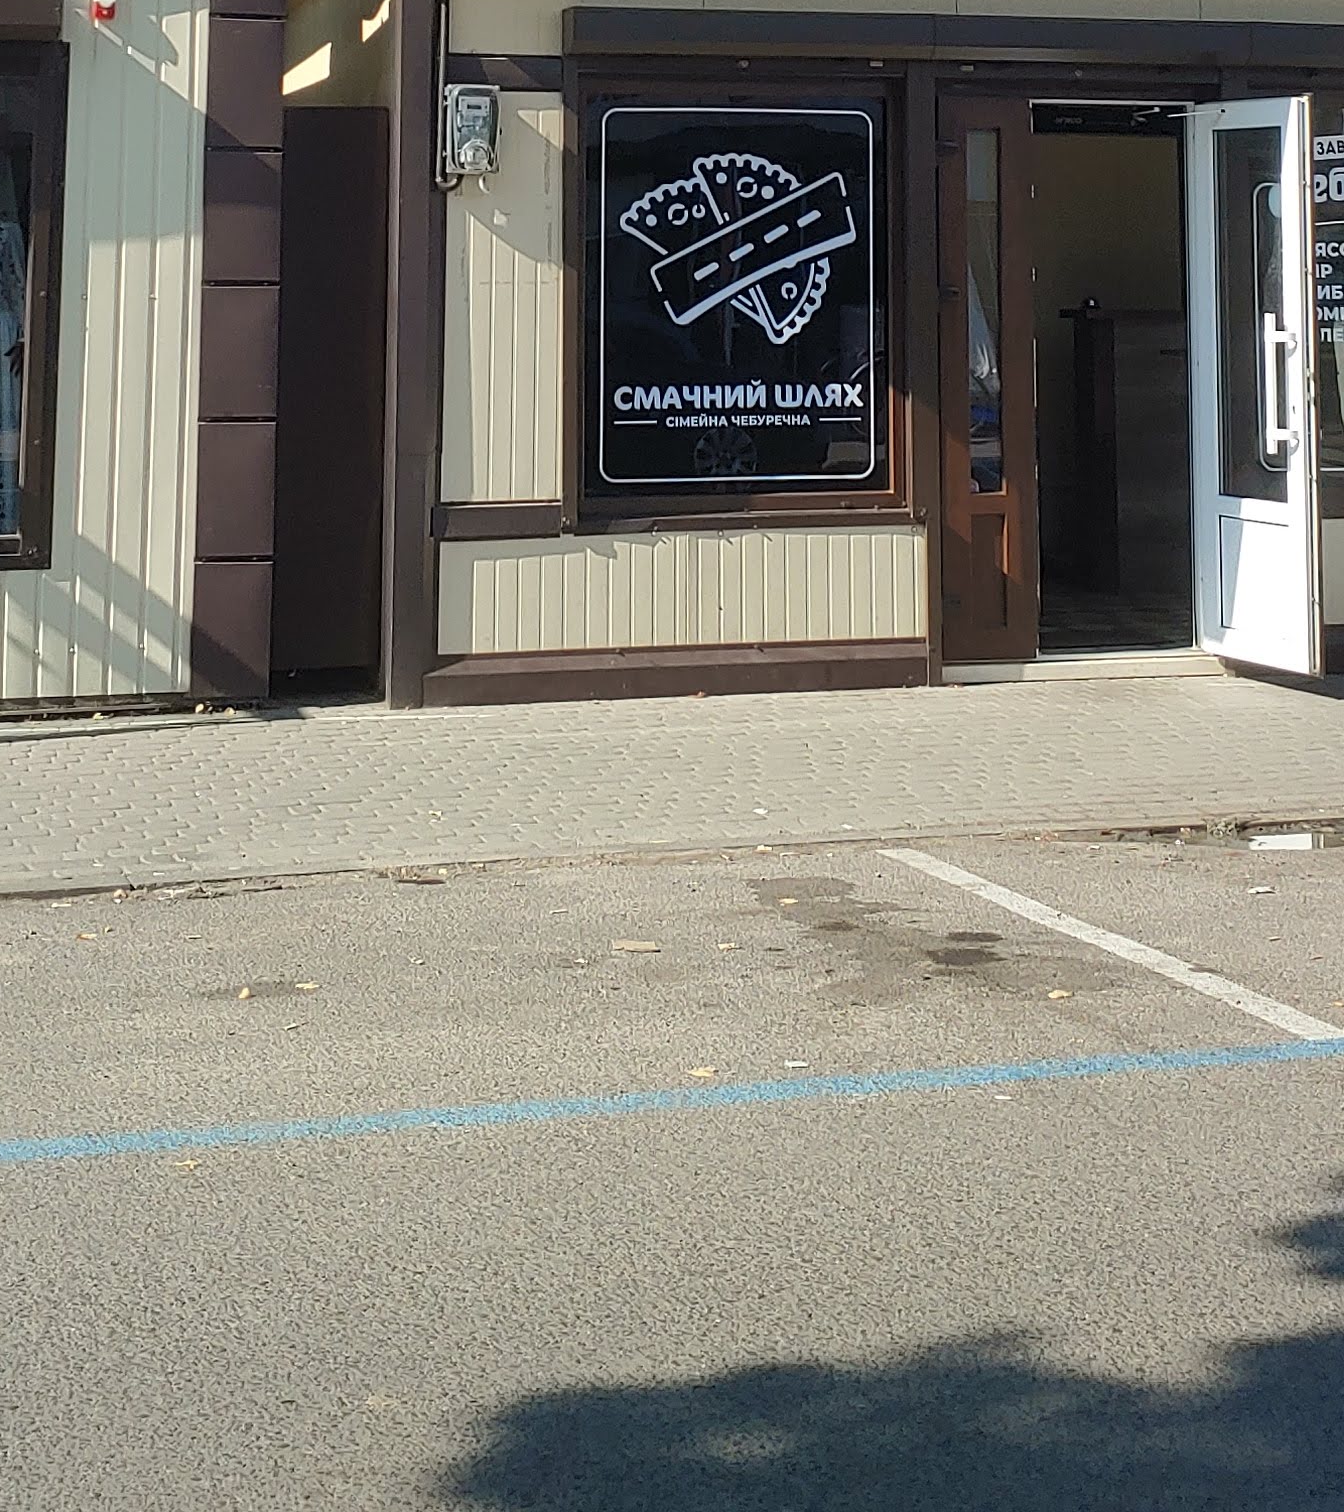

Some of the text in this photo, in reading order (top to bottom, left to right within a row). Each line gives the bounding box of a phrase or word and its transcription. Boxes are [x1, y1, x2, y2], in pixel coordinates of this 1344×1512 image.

[613, 379, 864, 411] СМАЧНИЙ ШЛЯХ
[666, 413, 811, 428] СІМЕЙНА ЧЕБУРЕЧНА
